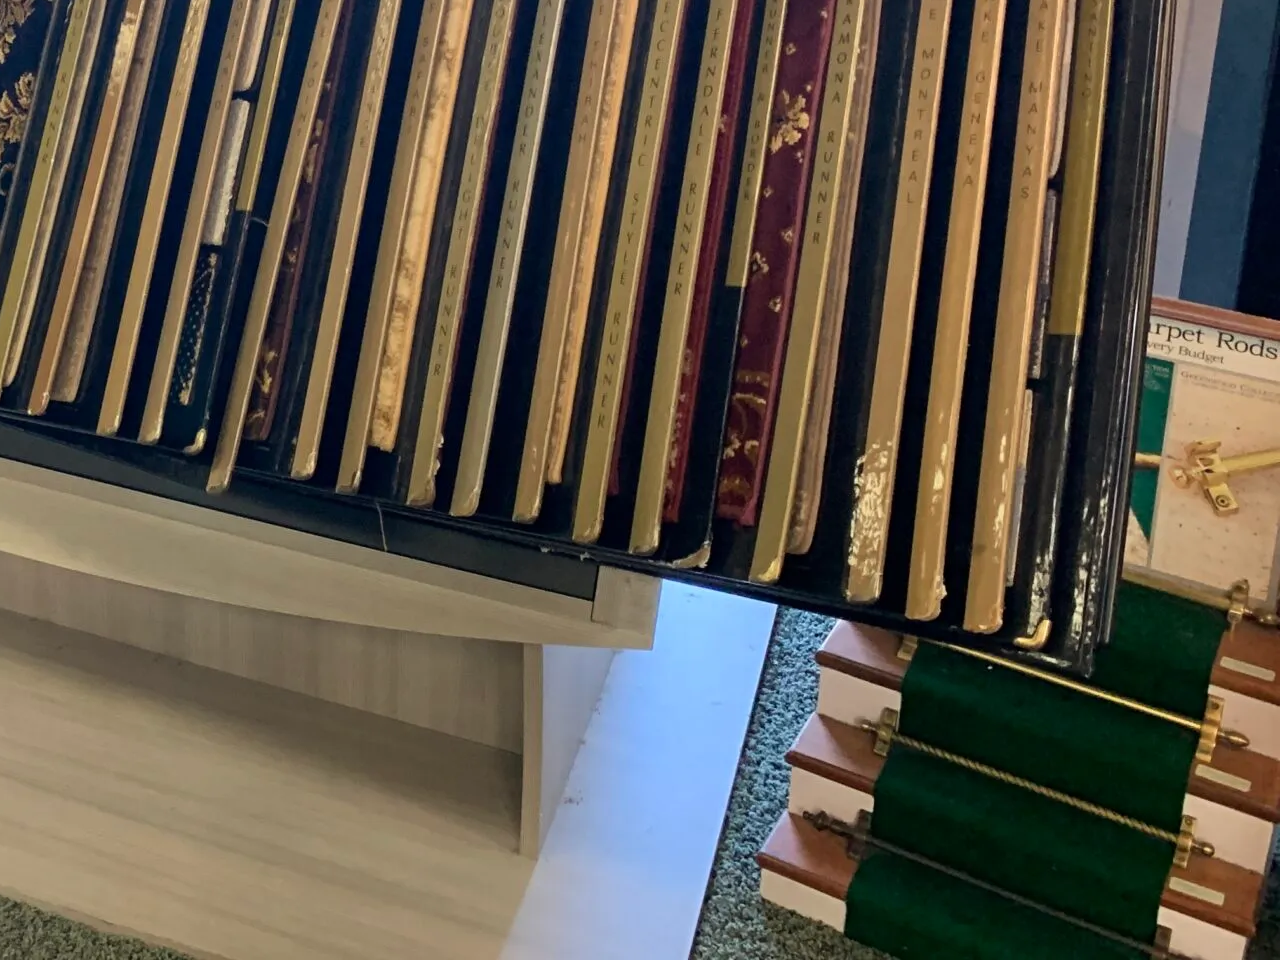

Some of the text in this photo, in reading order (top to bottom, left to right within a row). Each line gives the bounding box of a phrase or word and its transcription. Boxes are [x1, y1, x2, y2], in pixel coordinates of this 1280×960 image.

[638, 1, 670, 167] ECCENTRIC
[696, 8, 722, 156] FERNDALE
[907, 48, 934, 204] MONTREAL
[963, 71, 986, 187] GENEVA
[812, 131, 835, 244] RUNNER
[1021, 81, 1042, 200] MANYAS
[496, 179, 520, 289] RUNNER
[620, 193, 639, 286] STYLE
[674, 183, 697, 296] RUNNER
[434, 266, 457, 376] RUNNER
[598, 313, 621, 428] RUNNER
[1147, 342, 1225, 364] very Budget
[1148, 322, 1279, 360] rpet Rods
